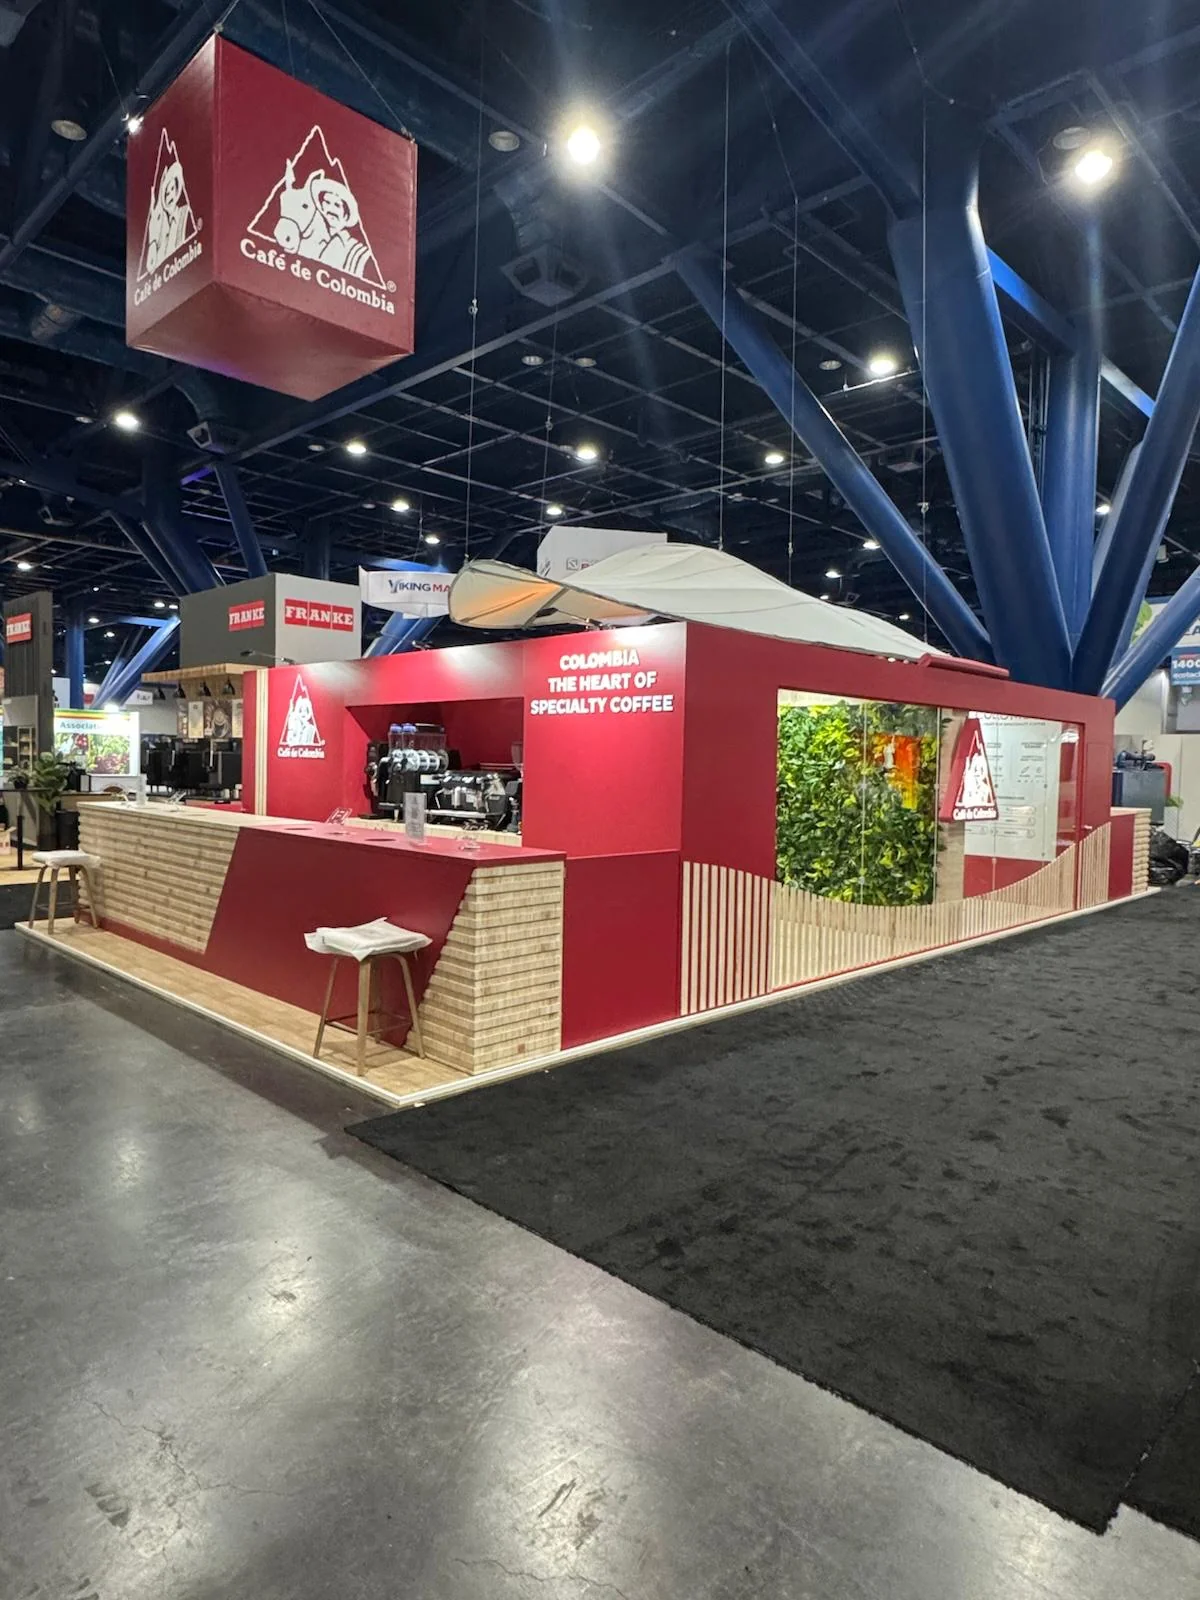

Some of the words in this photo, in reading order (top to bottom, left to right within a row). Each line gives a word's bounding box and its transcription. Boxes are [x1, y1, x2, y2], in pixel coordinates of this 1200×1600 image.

[134, 280, 152, 306] Café
[153, 273, 162, 292] de
[163, 239, 202, 283] Colombia
[240, 238, 286, 271] Café
[290, 260, 312, 281] de
[316, 269, 395, 315] Colombia
[432, 583, 451, 593] MA
[229, 607, 265, 625] FRANKE
[285, 605, 354, 625] FRANKE
[559, 649, 640, 671] COLOMBIA
[548, 676, 577, 693] THE
[579, 672, 631, 692] HEART
[634, 671, 657, 689] OF
[530, 697, 608, 715] SPECIALTY
[610, 694, 674, 713] COFFEE
[60, 721, 102, 730] Associat
